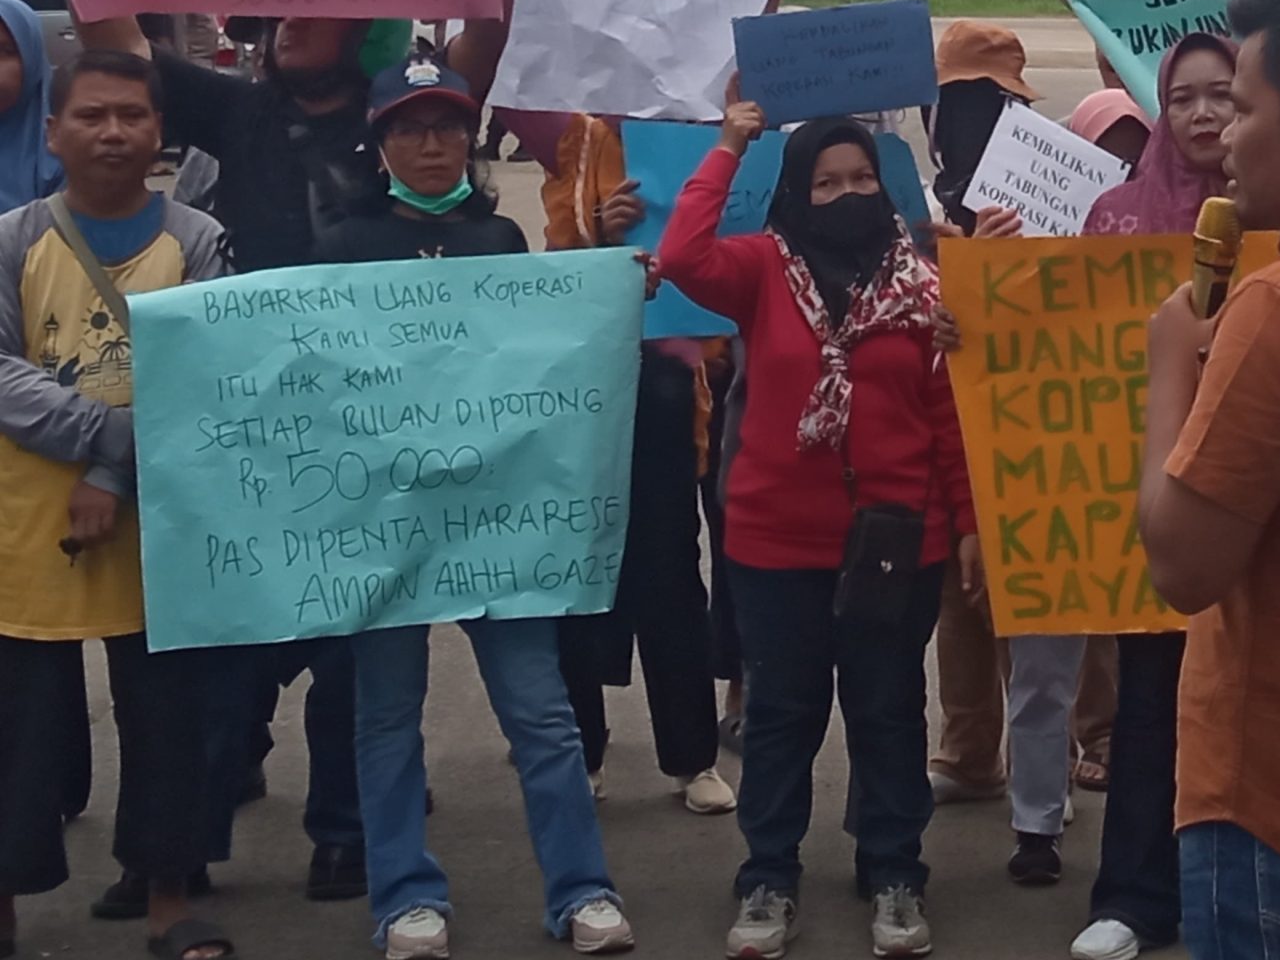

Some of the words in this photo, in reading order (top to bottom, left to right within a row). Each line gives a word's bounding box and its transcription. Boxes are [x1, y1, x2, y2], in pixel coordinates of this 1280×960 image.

[1011, 125, 1107, 186] KEMBALIKAN
[1030, 159, 1071, 191] UANG
[978, 180, 1049, 229] KOPERASI
[1005, 169, 1081, 222] TABUNGAN
[204, 282, 356, 325] BAYARKAN
[374, 280, 452, 312] UANG
[981, 247, 1178, 318] KEMB
[388, 320, 470, 349] SEMUA
[217, 372, 258, 403] ITU
[278, 370, 325, 396] HAK
[342, 365, 403, 393] KAMI
[989, 375, 1150, 434] KOPE
[194, 413, 313, 453] SETIAP
[341, 401, 440, 438] BULAN
[455, 387, 603, 432] DIPOTONG
[204, 533, 261, 588] PAS
[283, 514, 428, 574] DIPENTA
[997, 499, 1146, 566] KAPA
[294, 568, 420, 624] AMPUN
[1003, 564, 1169, 620] SAYA
